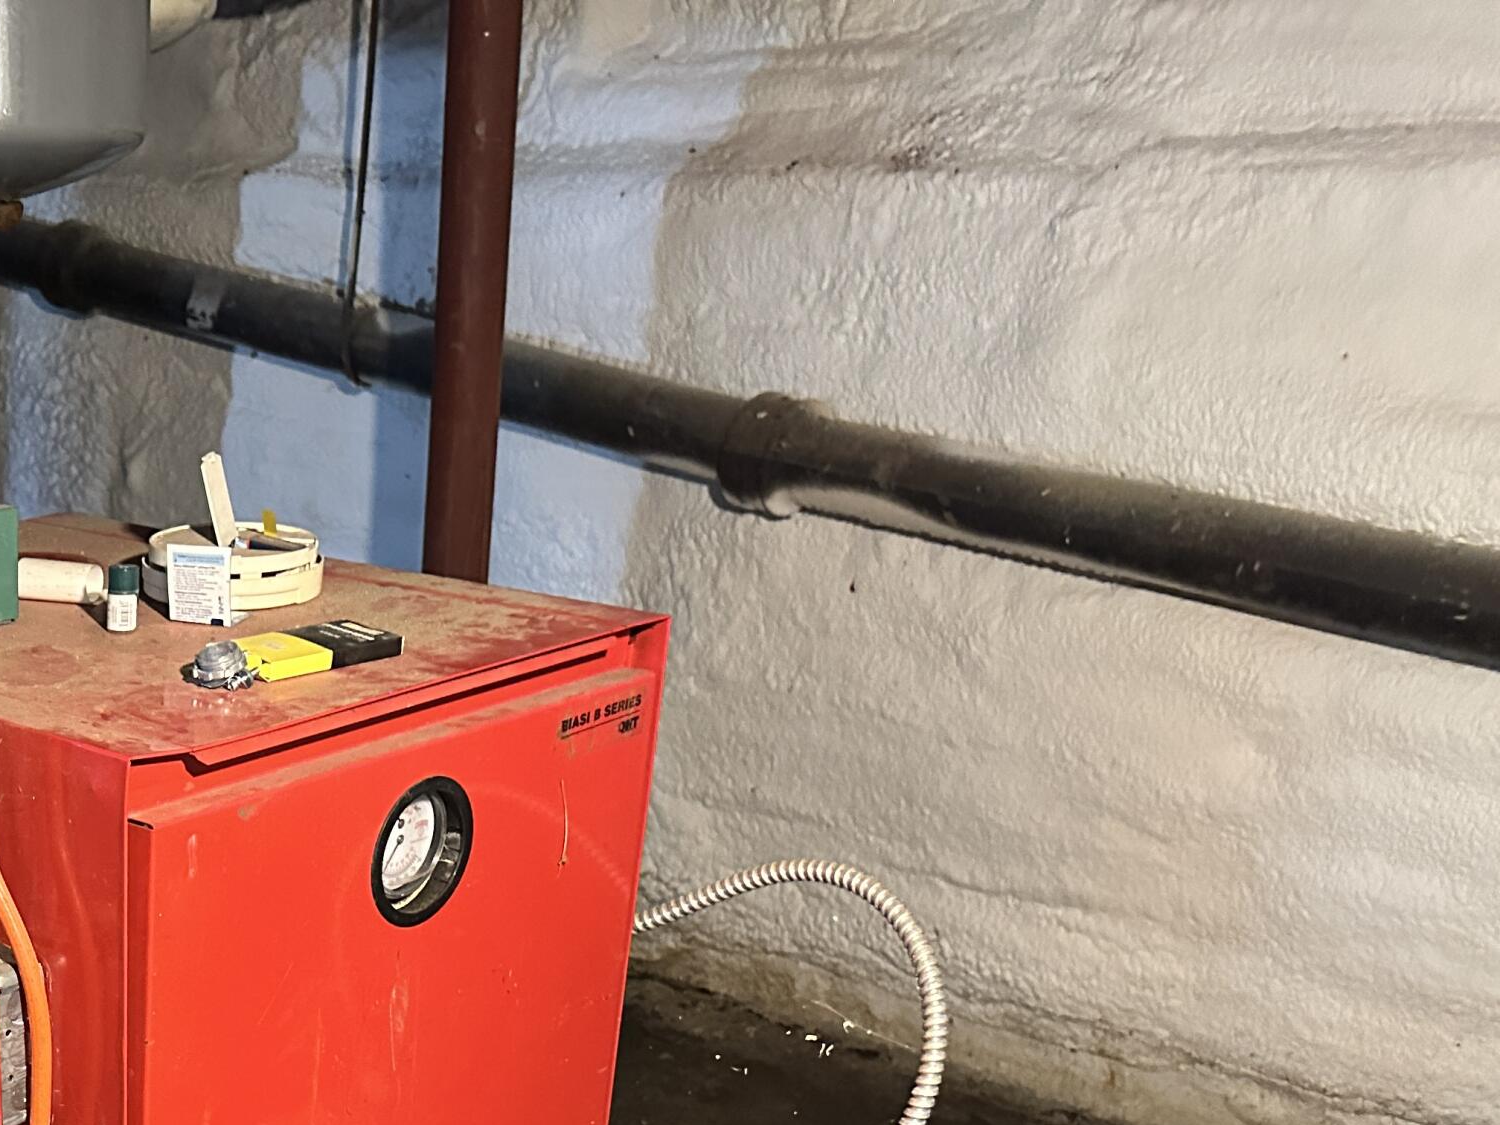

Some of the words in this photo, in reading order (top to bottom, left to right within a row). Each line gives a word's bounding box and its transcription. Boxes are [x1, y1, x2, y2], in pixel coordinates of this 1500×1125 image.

[561, 711, 591, 733] BIASI
[594, 708, 602, 721] B
[604, 693, 642, 717] SERIES
